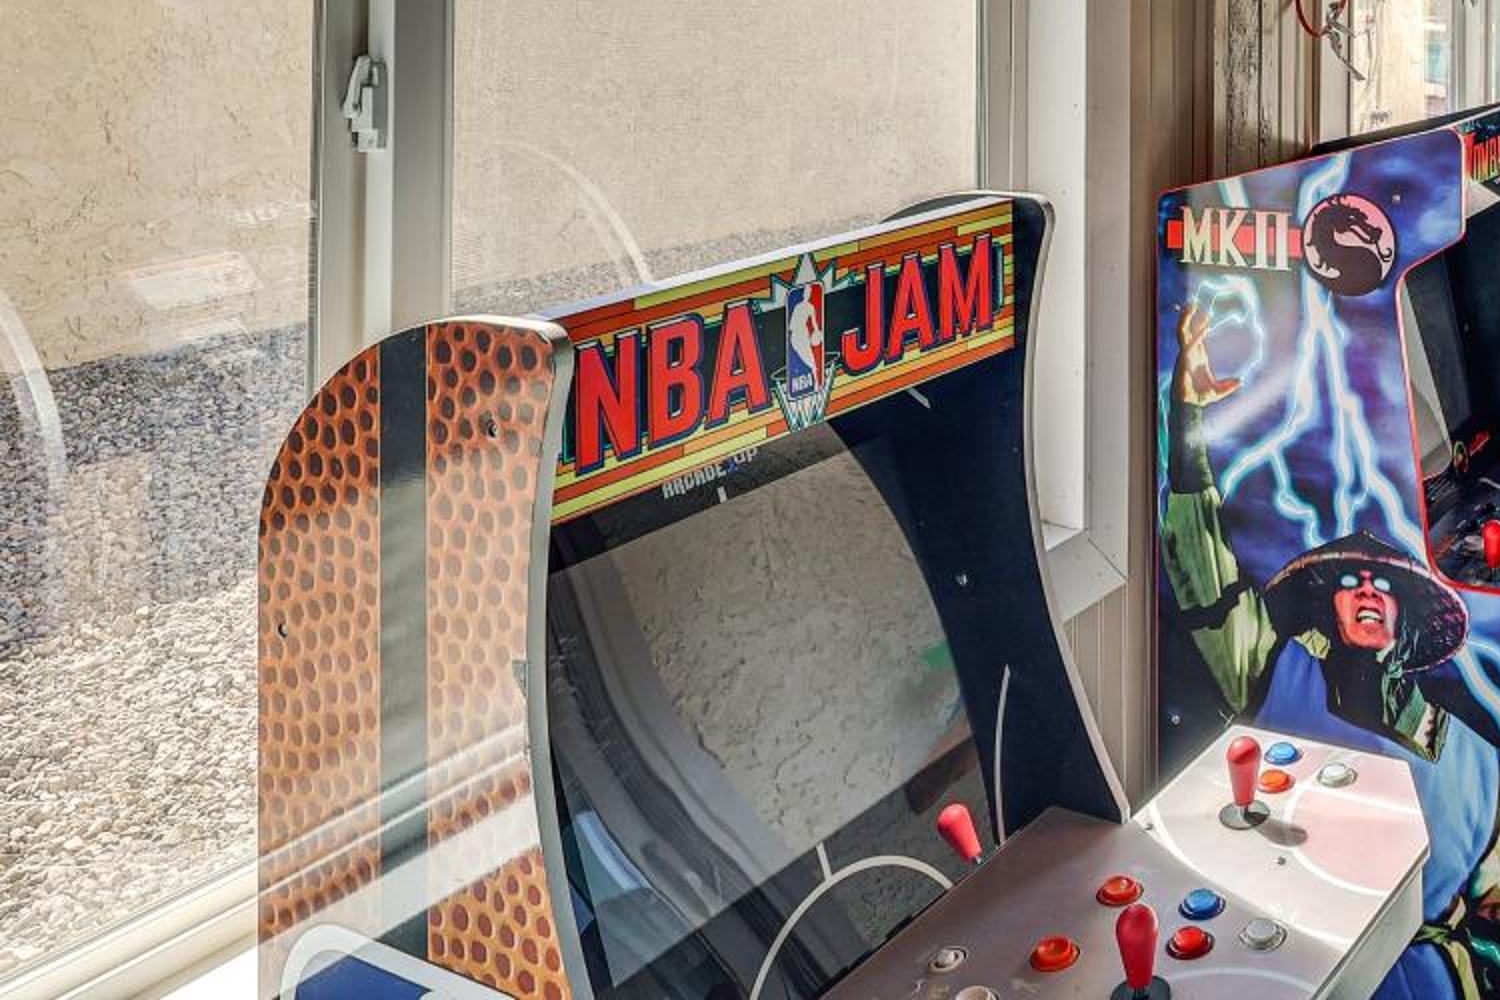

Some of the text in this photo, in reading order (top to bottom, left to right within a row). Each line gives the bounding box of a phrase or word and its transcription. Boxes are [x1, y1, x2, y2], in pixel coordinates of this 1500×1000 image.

[575, 233, 1000, 475] NBA JAM
[791, 373, 813, 393] NBA
